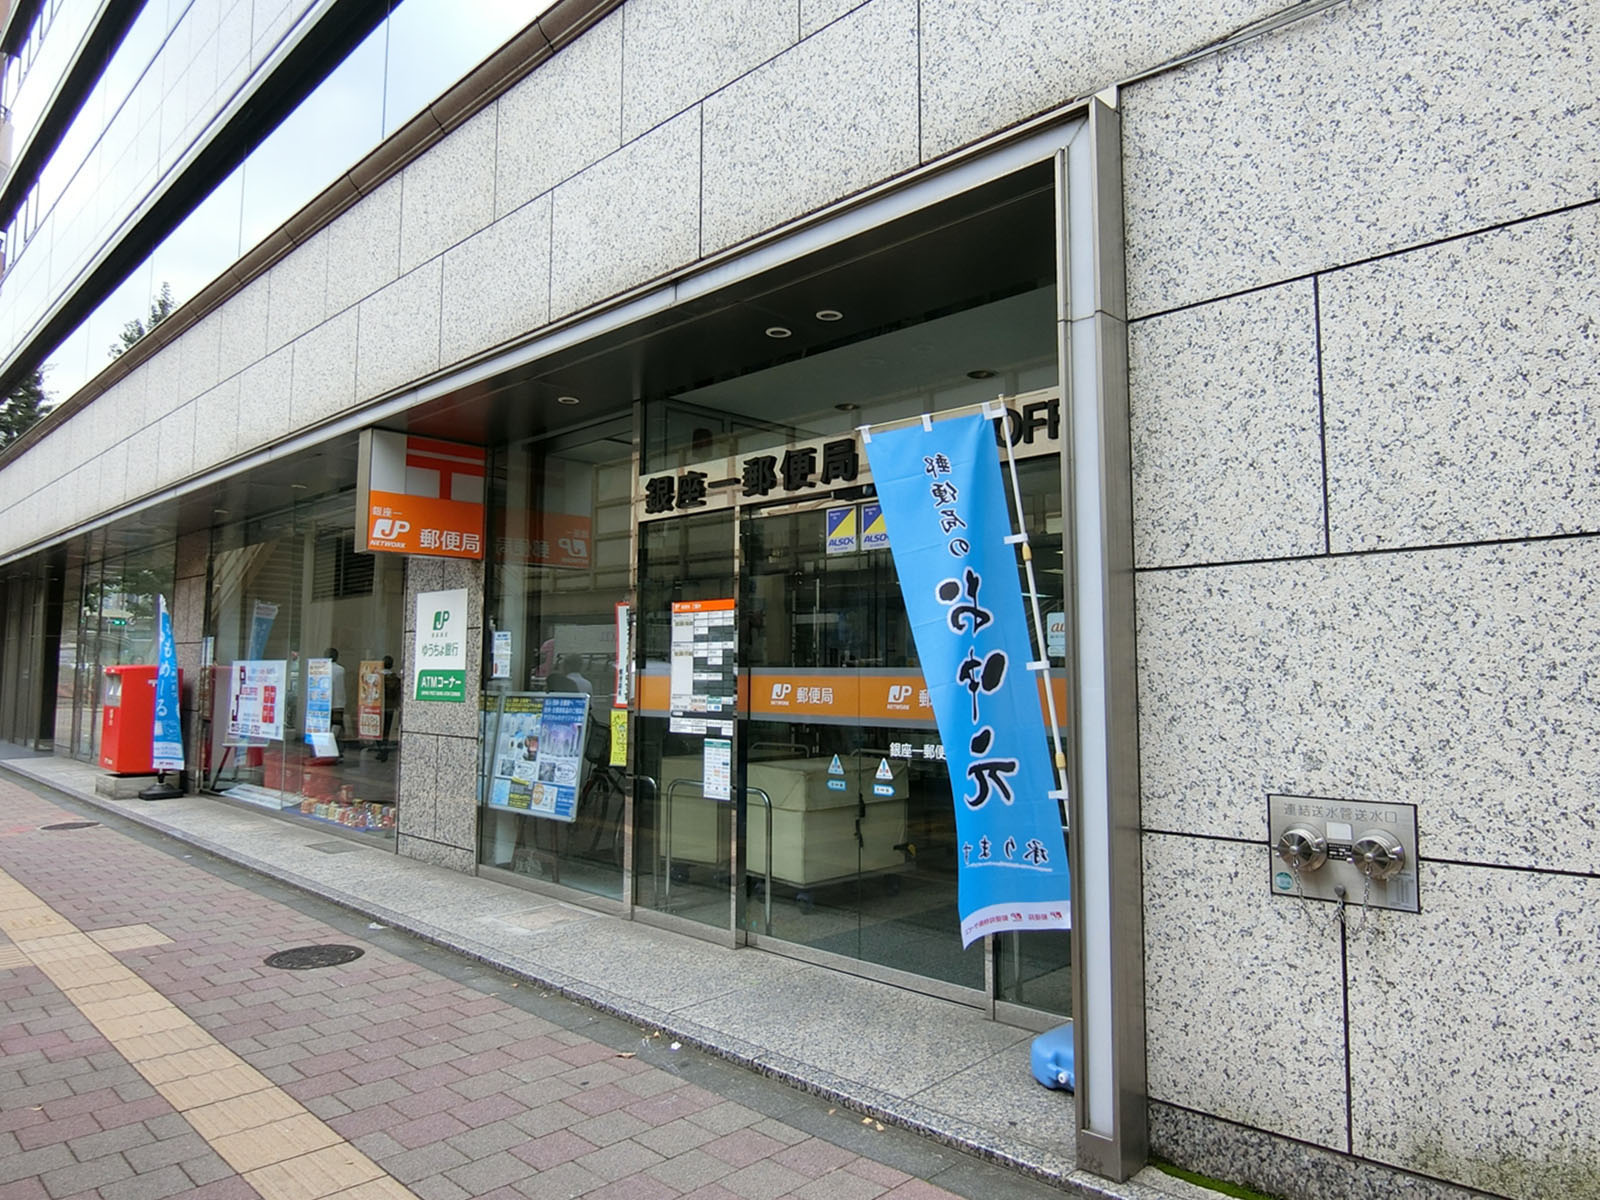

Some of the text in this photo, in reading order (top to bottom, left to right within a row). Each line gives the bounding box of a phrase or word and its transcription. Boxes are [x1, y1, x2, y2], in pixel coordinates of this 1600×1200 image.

[645, 438, 859, 514] 銀座一郵便局
[370, 540, 406, 548] NETWORK
[372, 518, 480, 553] JP 郵便局
[864, 533, 888, 543] ALSO
[433, 611, 450, 630] JP
[422, 643, 459, 656] ゆうちょ銀行
[421, 676, 461, 689] ATMコーナー
[771, 683, 833, 704] JP 郵便局
[888, 685, 912, 703] JP
[1284, 803, 1398, 823] 連結送水管送水口
